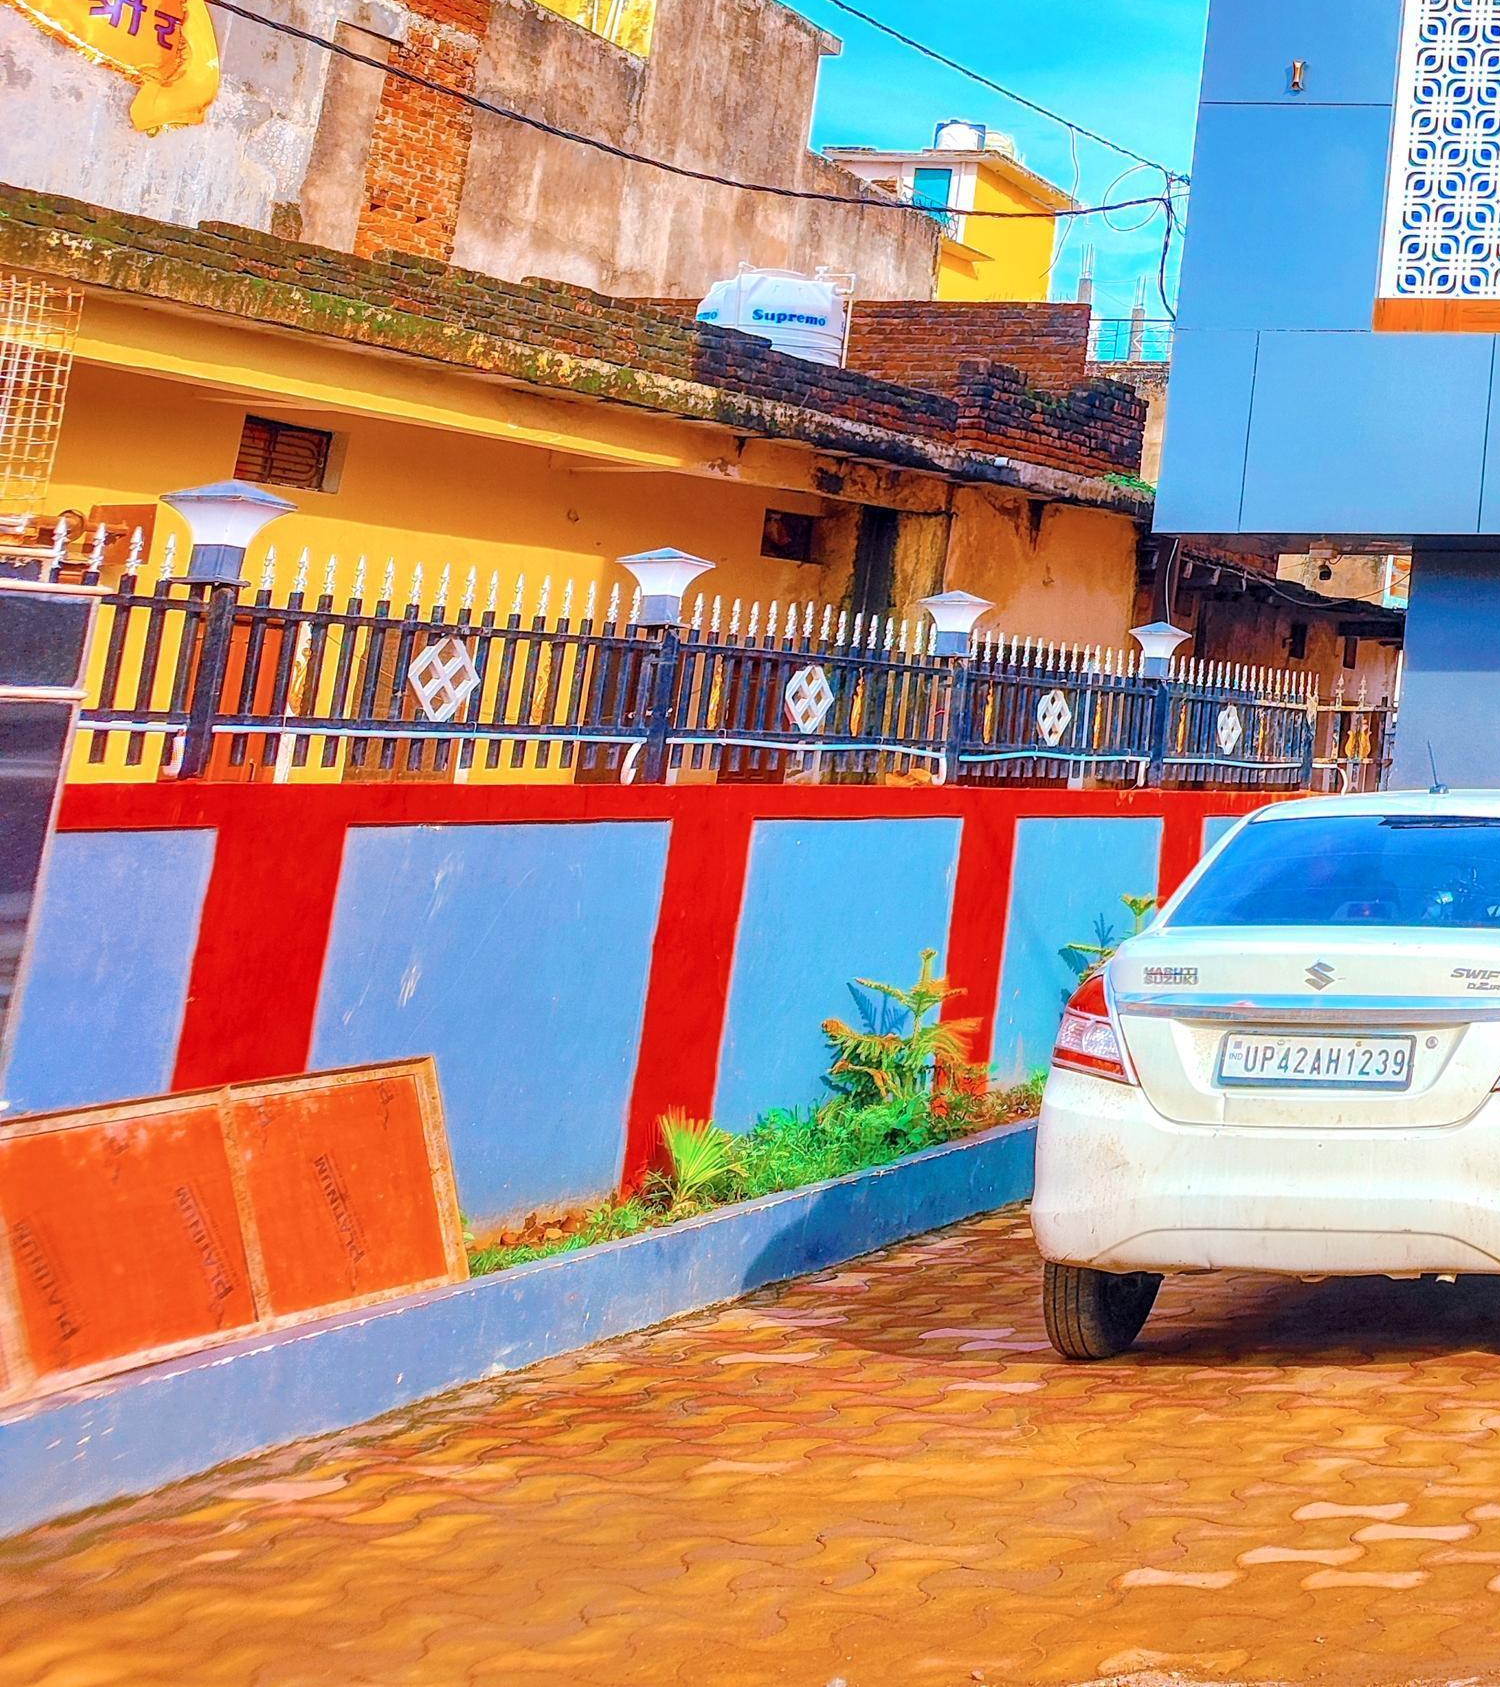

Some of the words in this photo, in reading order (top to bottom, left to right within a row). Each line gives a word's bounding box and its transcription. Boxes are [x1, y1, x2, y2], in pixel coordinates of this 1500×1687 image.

[752, 308, 828, 327] Supremo
[1143, 975, 1200, 985] SUZUKI
[1228, 1052, 1243, 1060] IND
[1244, 1045, 1406, 1076] UP42AH1239
